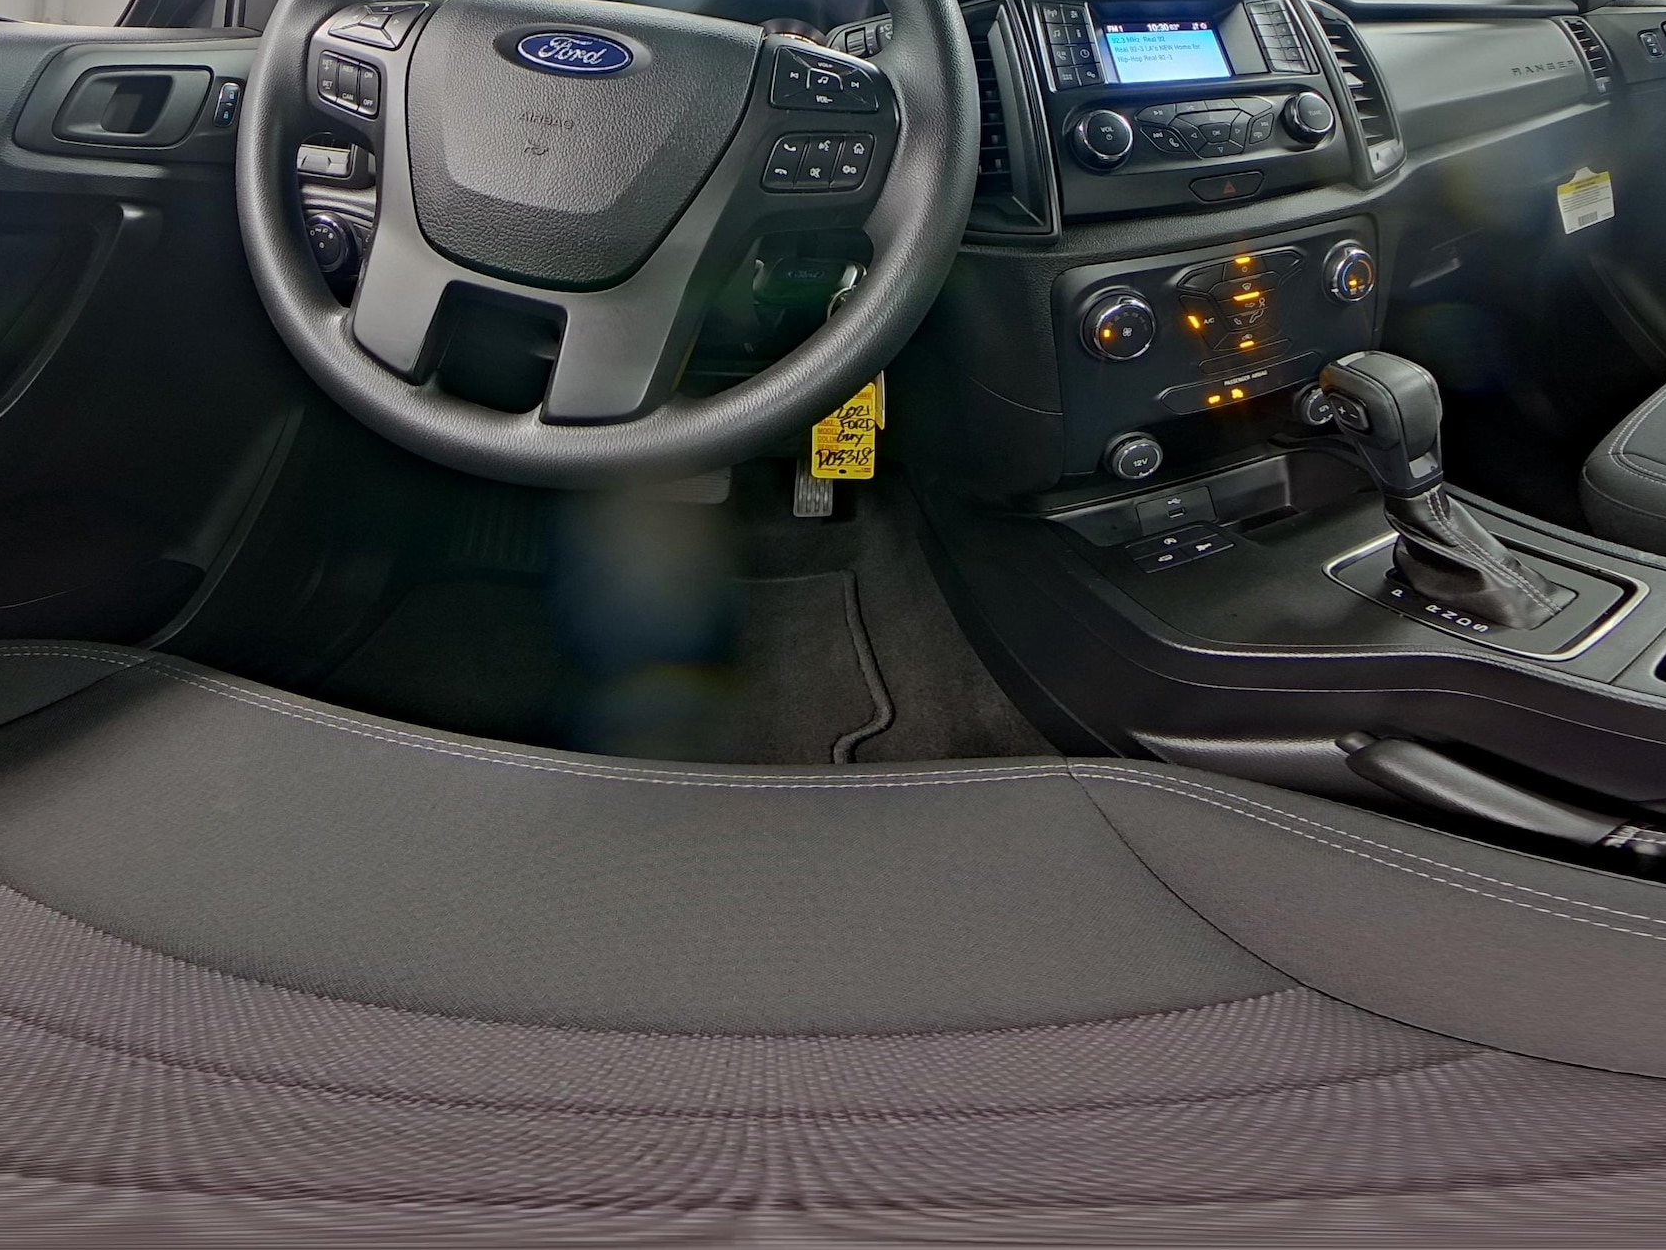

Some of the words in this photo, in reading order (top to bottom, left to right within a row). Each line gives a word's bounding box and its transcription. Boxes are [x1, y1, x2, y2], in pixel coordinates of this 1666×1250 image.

[1107, 25, 1118, 33] FM
[1146, 23, 1169, 32] 10:30
[1111, 36, 1125, 44] 92.3
[538, 36, 607, 65] Ford
[1159, 44, 1174, 52] NEW
[342, 65, 354, 73] RES
[1511, 59, 1574, 77] RANGER
[364, 71, 374, 79] ON
[342, 92, 354, 100] CAN
[363, 99, 374, 107] OFF
[517, 111, 574, 130] AIRBAG
[1100, 126, 1114, 134] VOL
[1203, 317, 1215, 325] A/C
[836, 405, 871, 420] 2021
[840, 418, 876, 432] FORD
[1132, 457, 1148, 468] 12V
[1390, 588, 1404, 598] P
[1425, 604, 1442, 613] R
[1441, 610, 1458, 620] N
[1455, 617, 1472, 627] D
[1472, 623, 1489, 633] S
